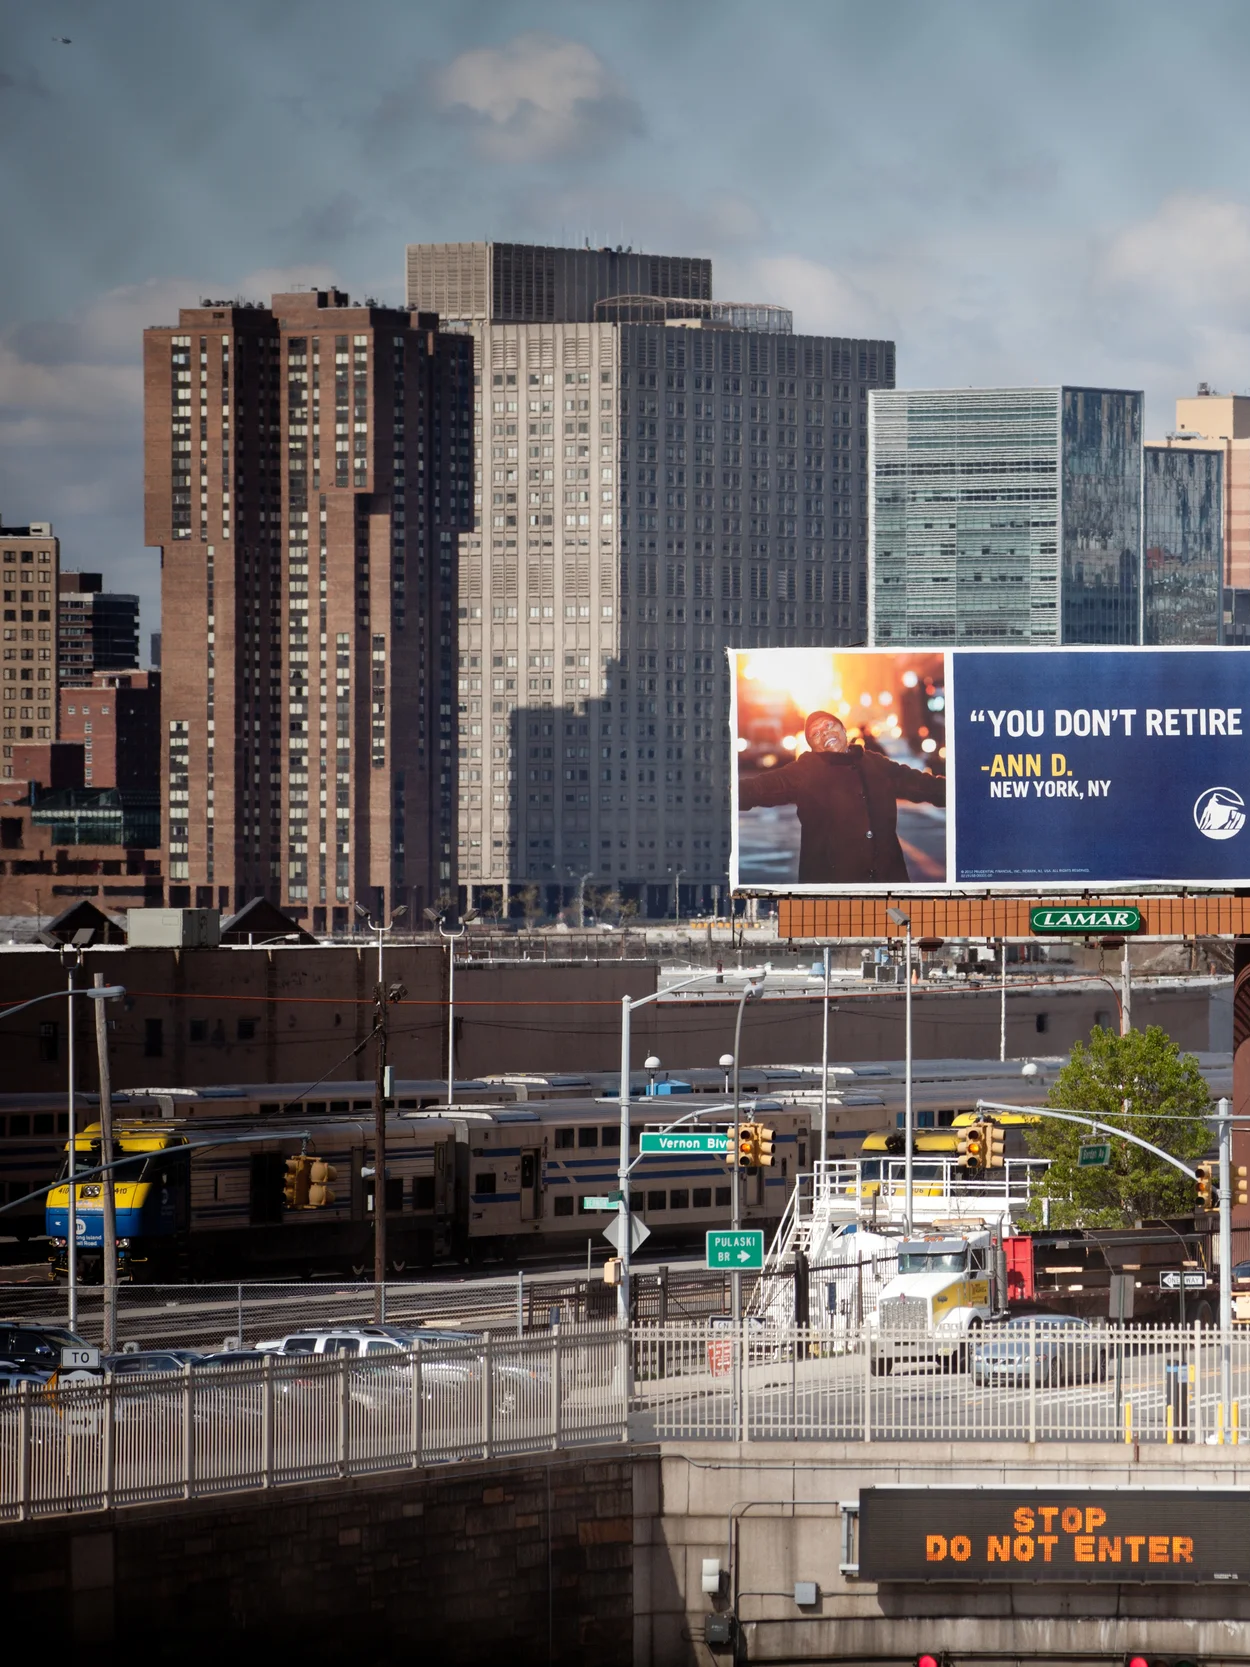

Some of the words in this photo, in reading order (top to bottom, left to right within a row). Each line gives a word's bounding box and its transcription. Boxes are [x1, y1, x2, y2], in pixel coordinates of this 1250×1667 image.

[970, 709, 1044, 737] “YOU
[1055, 709, 1137, 737] DON’T
[1146, 708, 1243, 736] RETIRE
[981, 754, 1042, 777] -ANN
[1051, 753, 1073, 777] D.
[990, 781, 1029, 798] NEW
[1032, 780, 1084, 800] YORK,
[1087, 780, 1112, 797] NY
[1043, 913, 1128, 925] LAMAR
[659, 1138, 700, 1149] Vernon
[715, 1237, 755, 1247] PULASKI
[717, 1252, 730, 1262] BR
[71, 1351, 90, 1364] TO
[1013, 1507, 1107, 1533] STOP
[926, 1535, 971, 1562] DO
[987, 1535, 1059, 1562] NOT
[1074, 1535, 1195, 1563] ENTER
